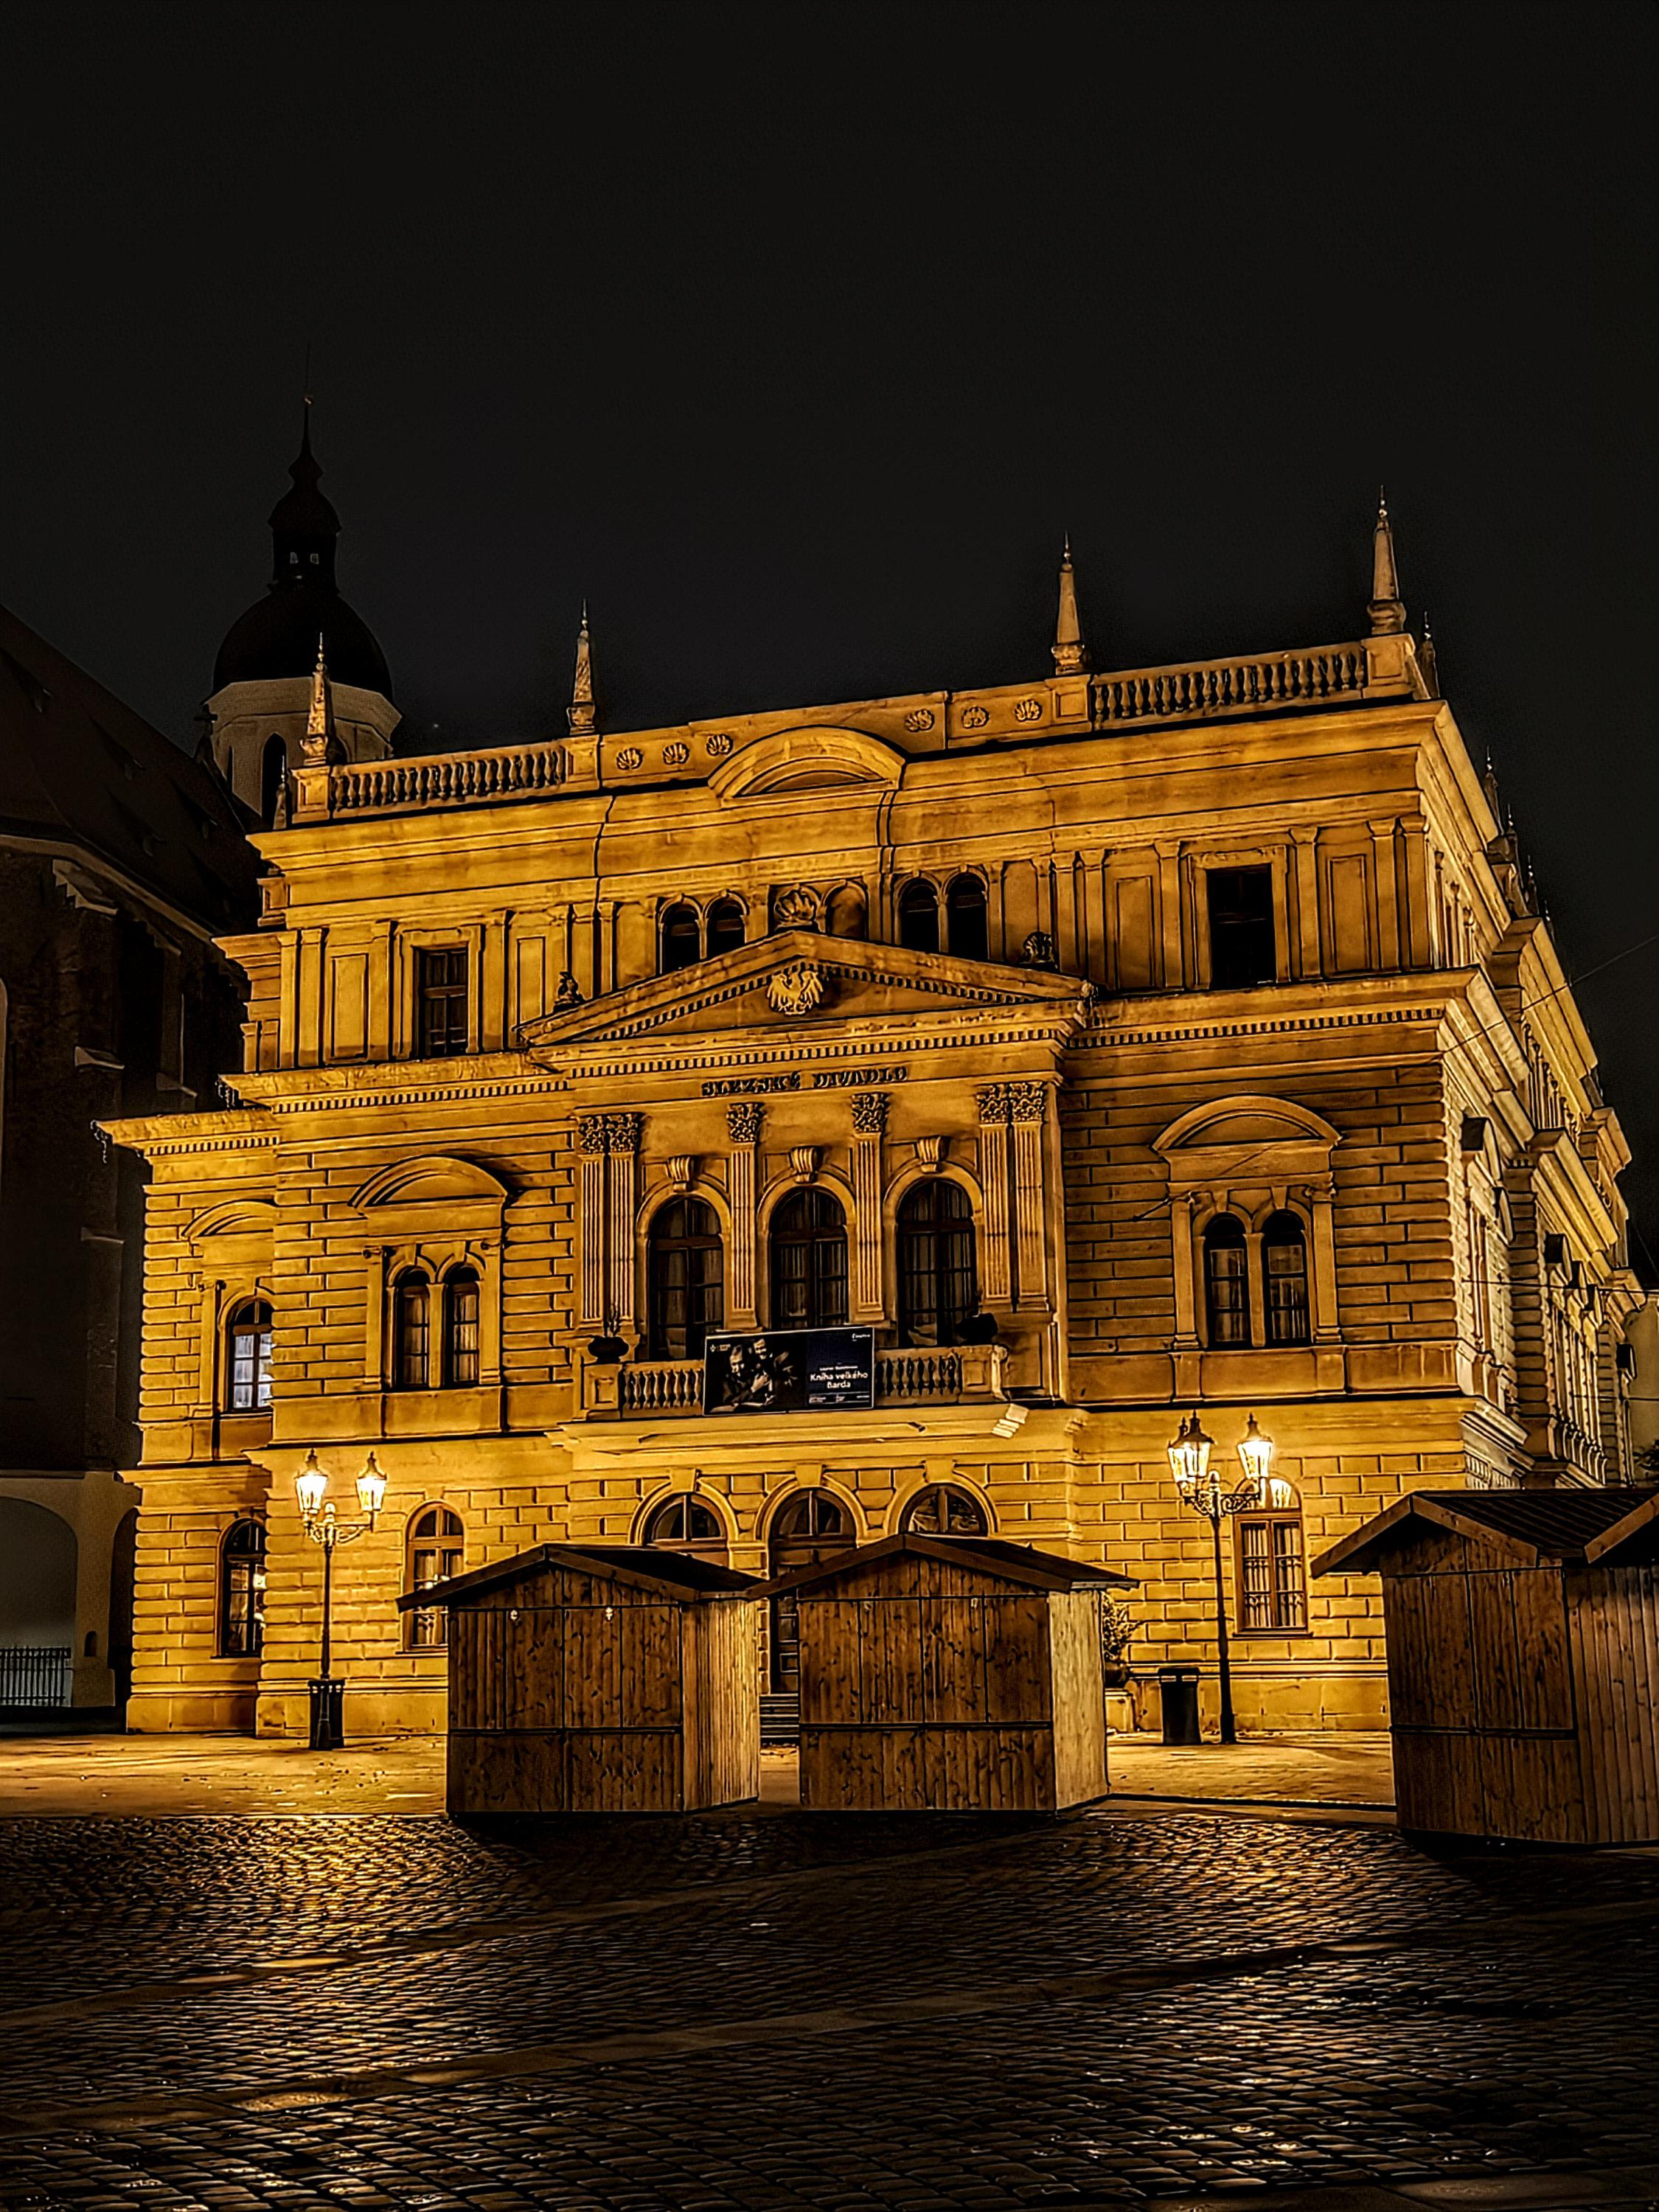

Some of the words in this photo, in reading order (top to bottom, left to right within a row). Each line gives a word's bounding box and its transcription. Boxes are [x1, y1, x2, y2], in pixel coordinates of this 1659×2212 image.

[812, 1066, 907, 1088] DIVADLO
[810, 1372, 834, 1381] Kniha
[827, 1380, 851, 1388] Barda
